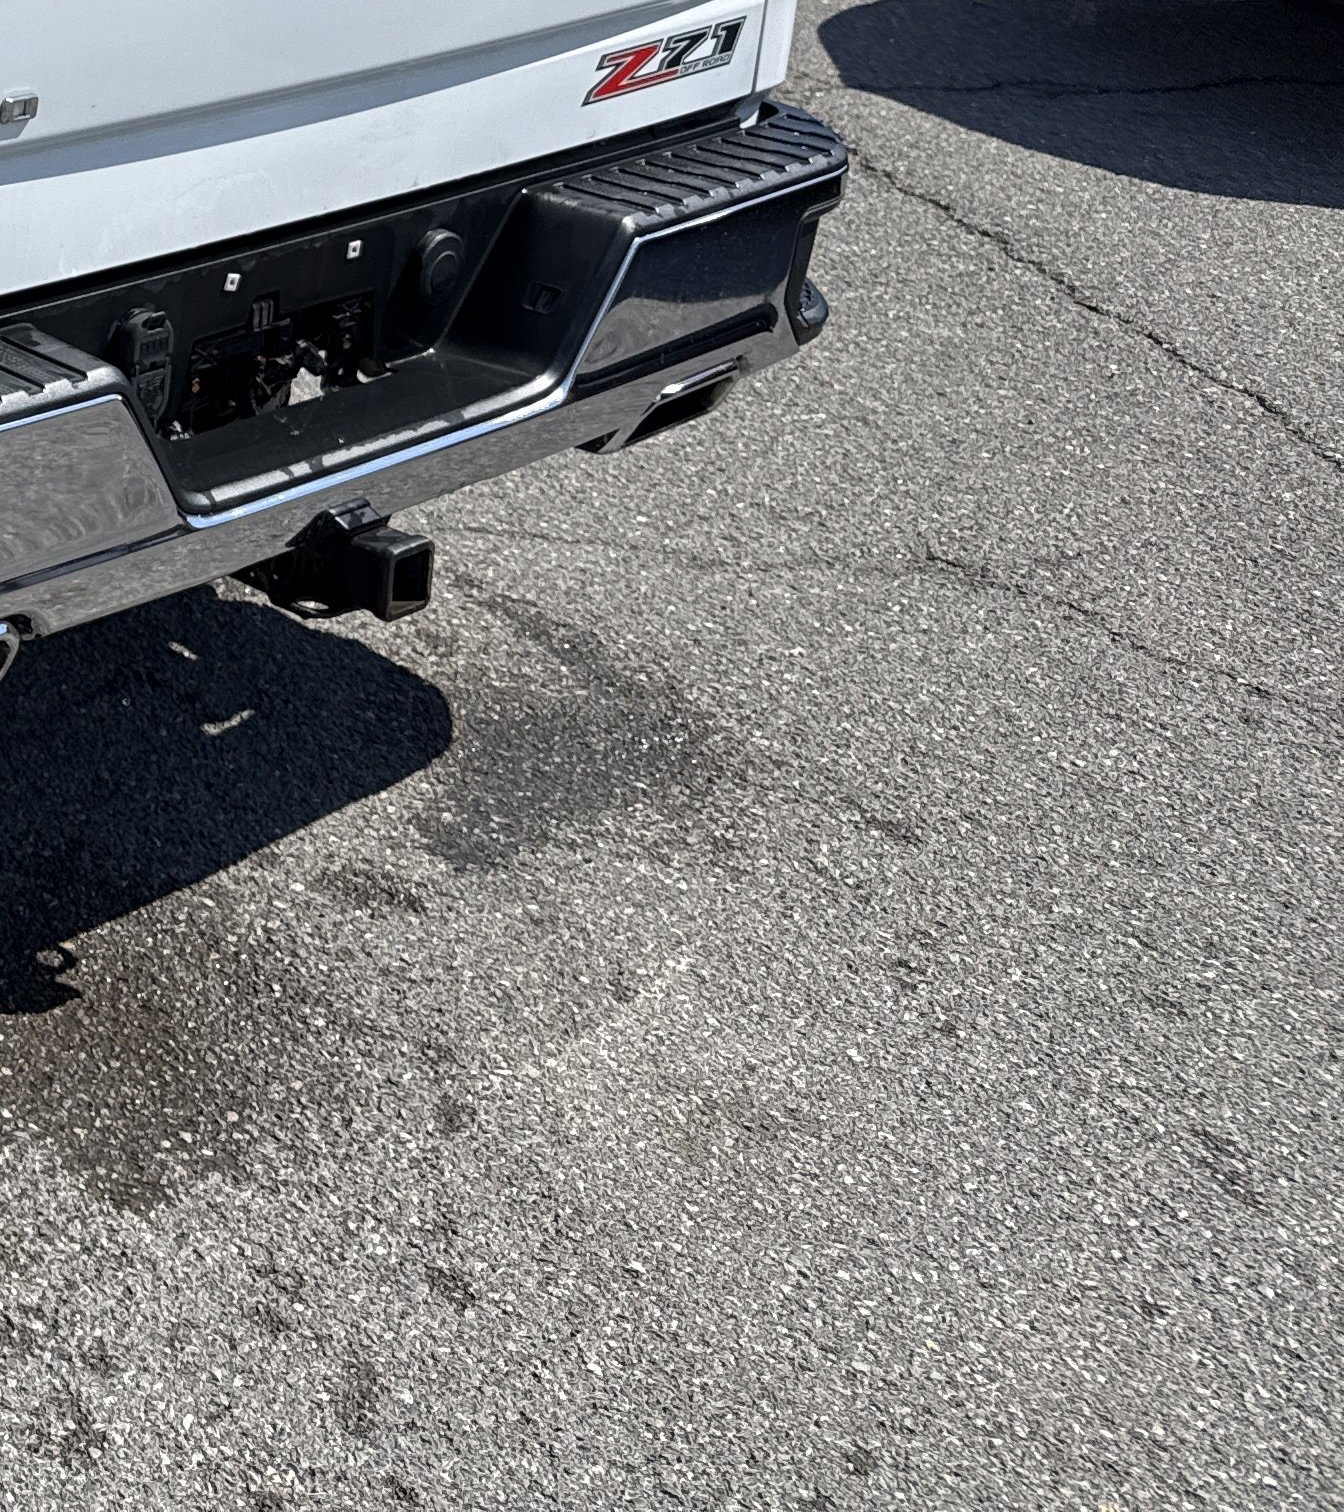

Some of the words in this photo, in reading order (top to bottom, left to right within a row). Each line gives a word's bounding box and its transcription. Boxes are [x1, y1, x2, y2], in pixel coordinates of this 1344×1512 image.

[581, 15, 747, 107] Z71
[679, 62, 700, 75] OFF
[702, 54, 731, 68] ROAD
